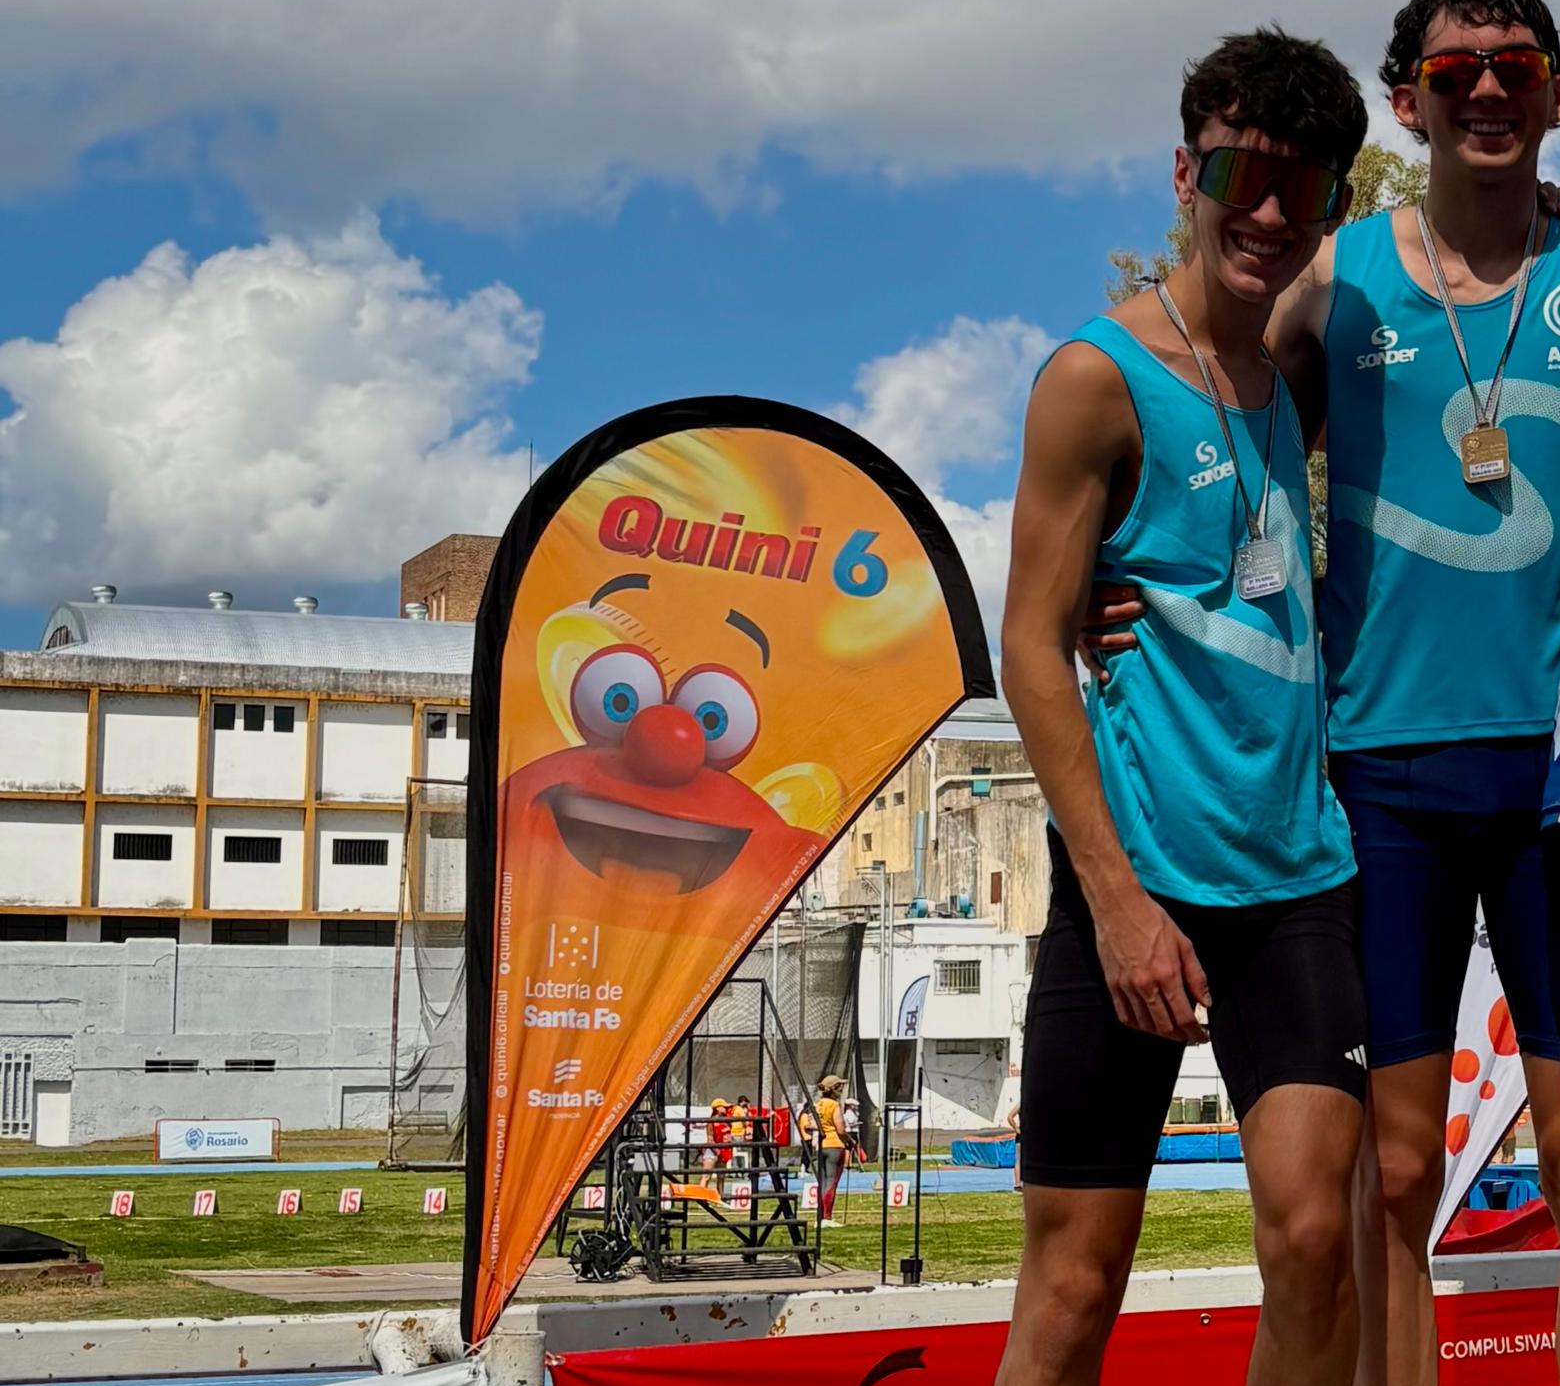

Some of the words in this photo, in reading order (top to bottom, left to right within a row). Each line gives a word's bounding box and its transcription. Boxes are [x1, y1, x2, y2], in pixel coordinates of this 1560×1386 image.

[598, 495, 822, 583] Quini
[832, 528, 889, 598] 6
[524, 976, 591, 999] Lotería
[595, 980, 624, 1001] de
[523, 1005, 590, 1029] Santa
[593, 1008, 621, 1030] Fe
[527, 1089, 582, 1107] Santa
[584, 1089, 605, 1107] Fe
[207, 1135, 249, 1146] Rosario
[116, 1193, 131, 1214] 18
[197, 1192, 213, 1213] 17
[282, 1192, 297, 1213] 16
[342, 1191, 358, 1212] 15
[426, 1191, 442, 1213] 14
[586, 1187, 602, 1208] 12
[892, 1184, 904, 1205] 8
